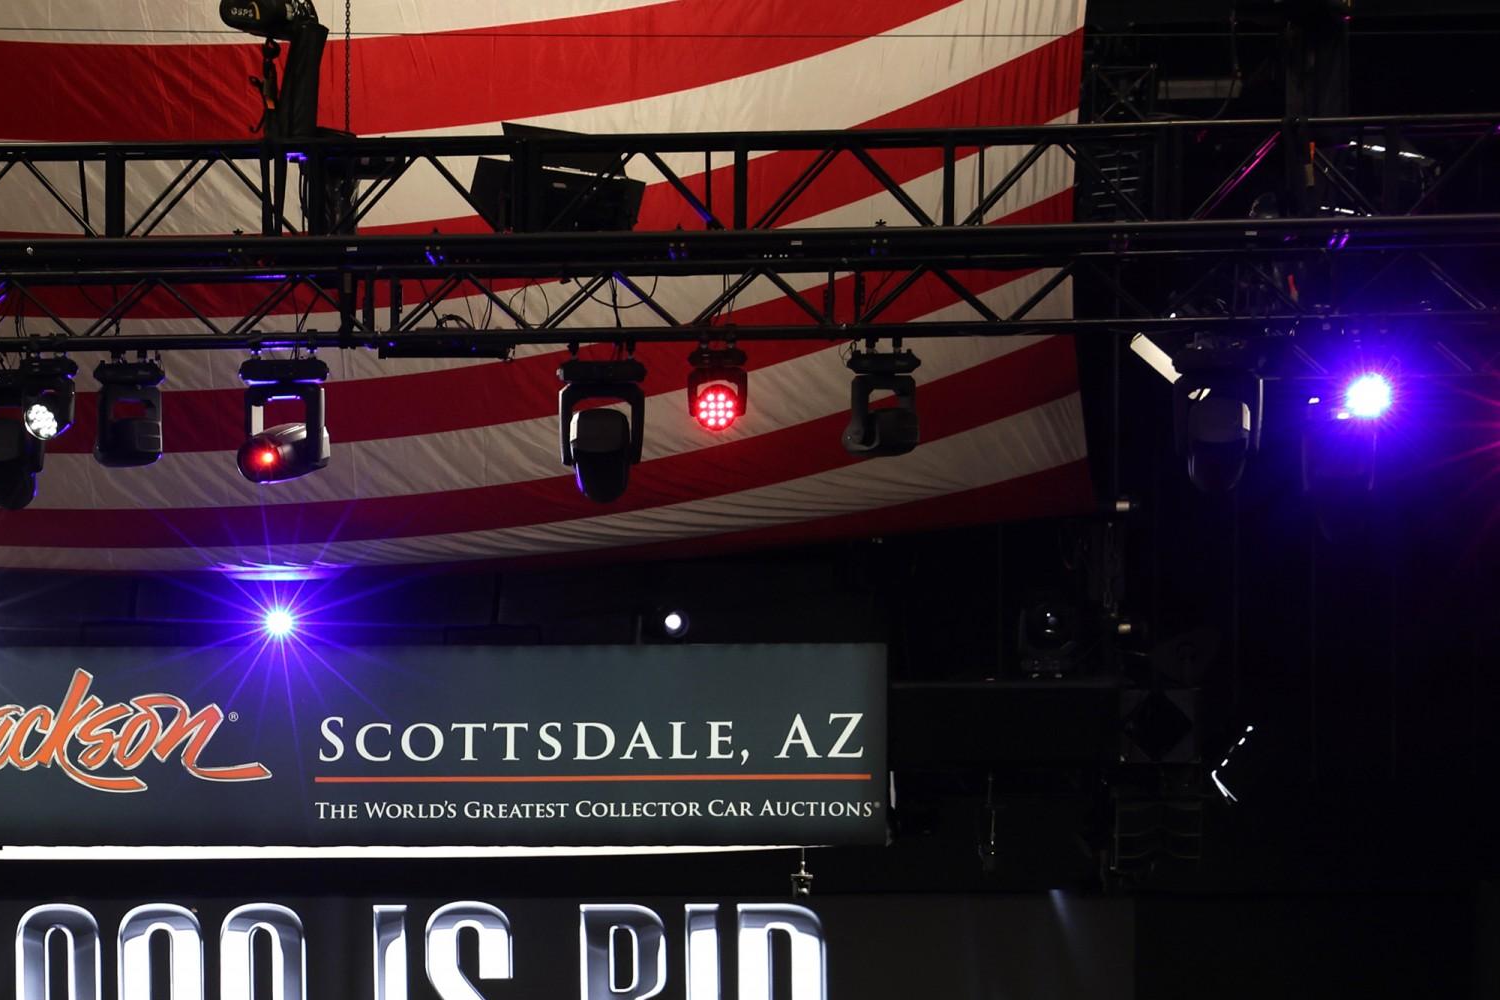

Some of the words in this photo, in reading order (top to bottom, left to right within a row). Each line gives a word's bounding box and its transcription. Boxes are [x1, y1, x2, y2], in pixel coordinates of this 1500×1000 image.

[318, 716, 751, 766] SCOTTSDALE,
[774, 712, 865, 759] AZ
[315, 801, 358, 820] THE
[364, 800, 457, 819] WORLD'S
[463, 800, 570, 819] GREATEST
[575, 799, 702, 818] COLLECTOR
[706, 799, 755, 818] CAR
